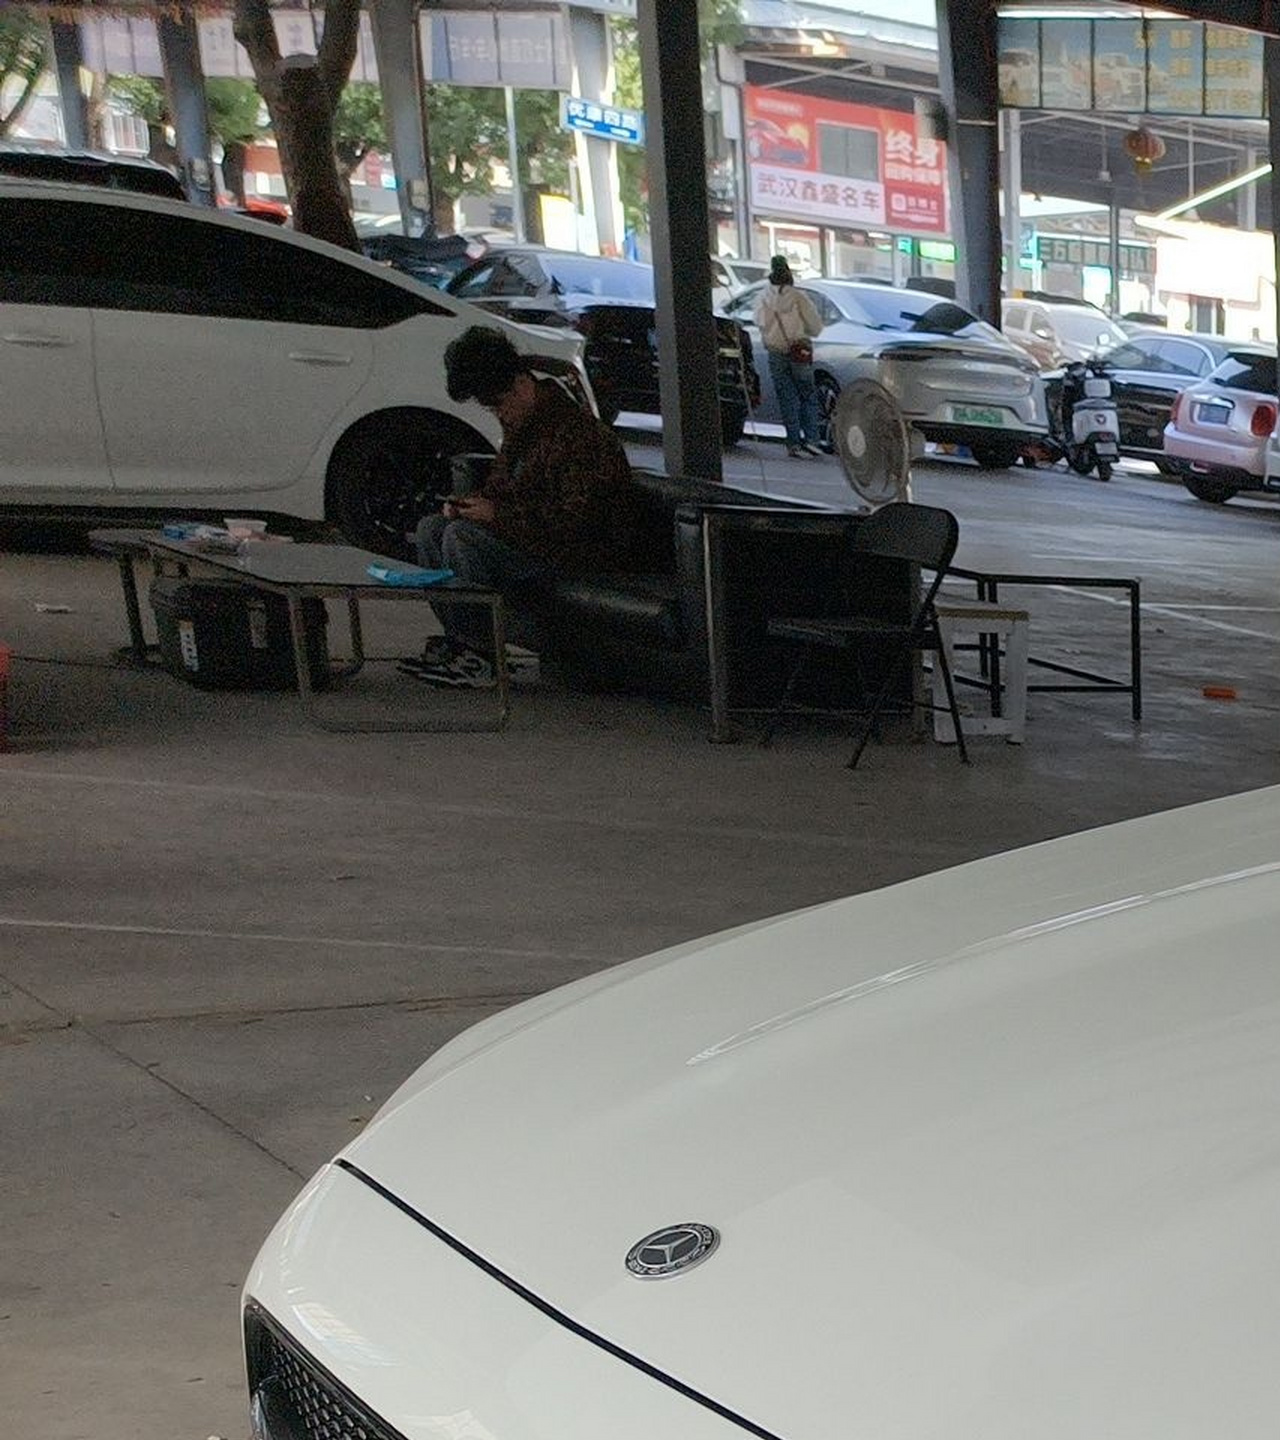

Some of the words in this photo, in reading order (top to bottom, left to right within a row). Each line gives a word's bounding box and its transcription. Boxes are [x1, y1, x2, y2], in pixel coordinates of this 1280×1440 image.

[757, 172, 880, 211] 武汉鑫盛名车
